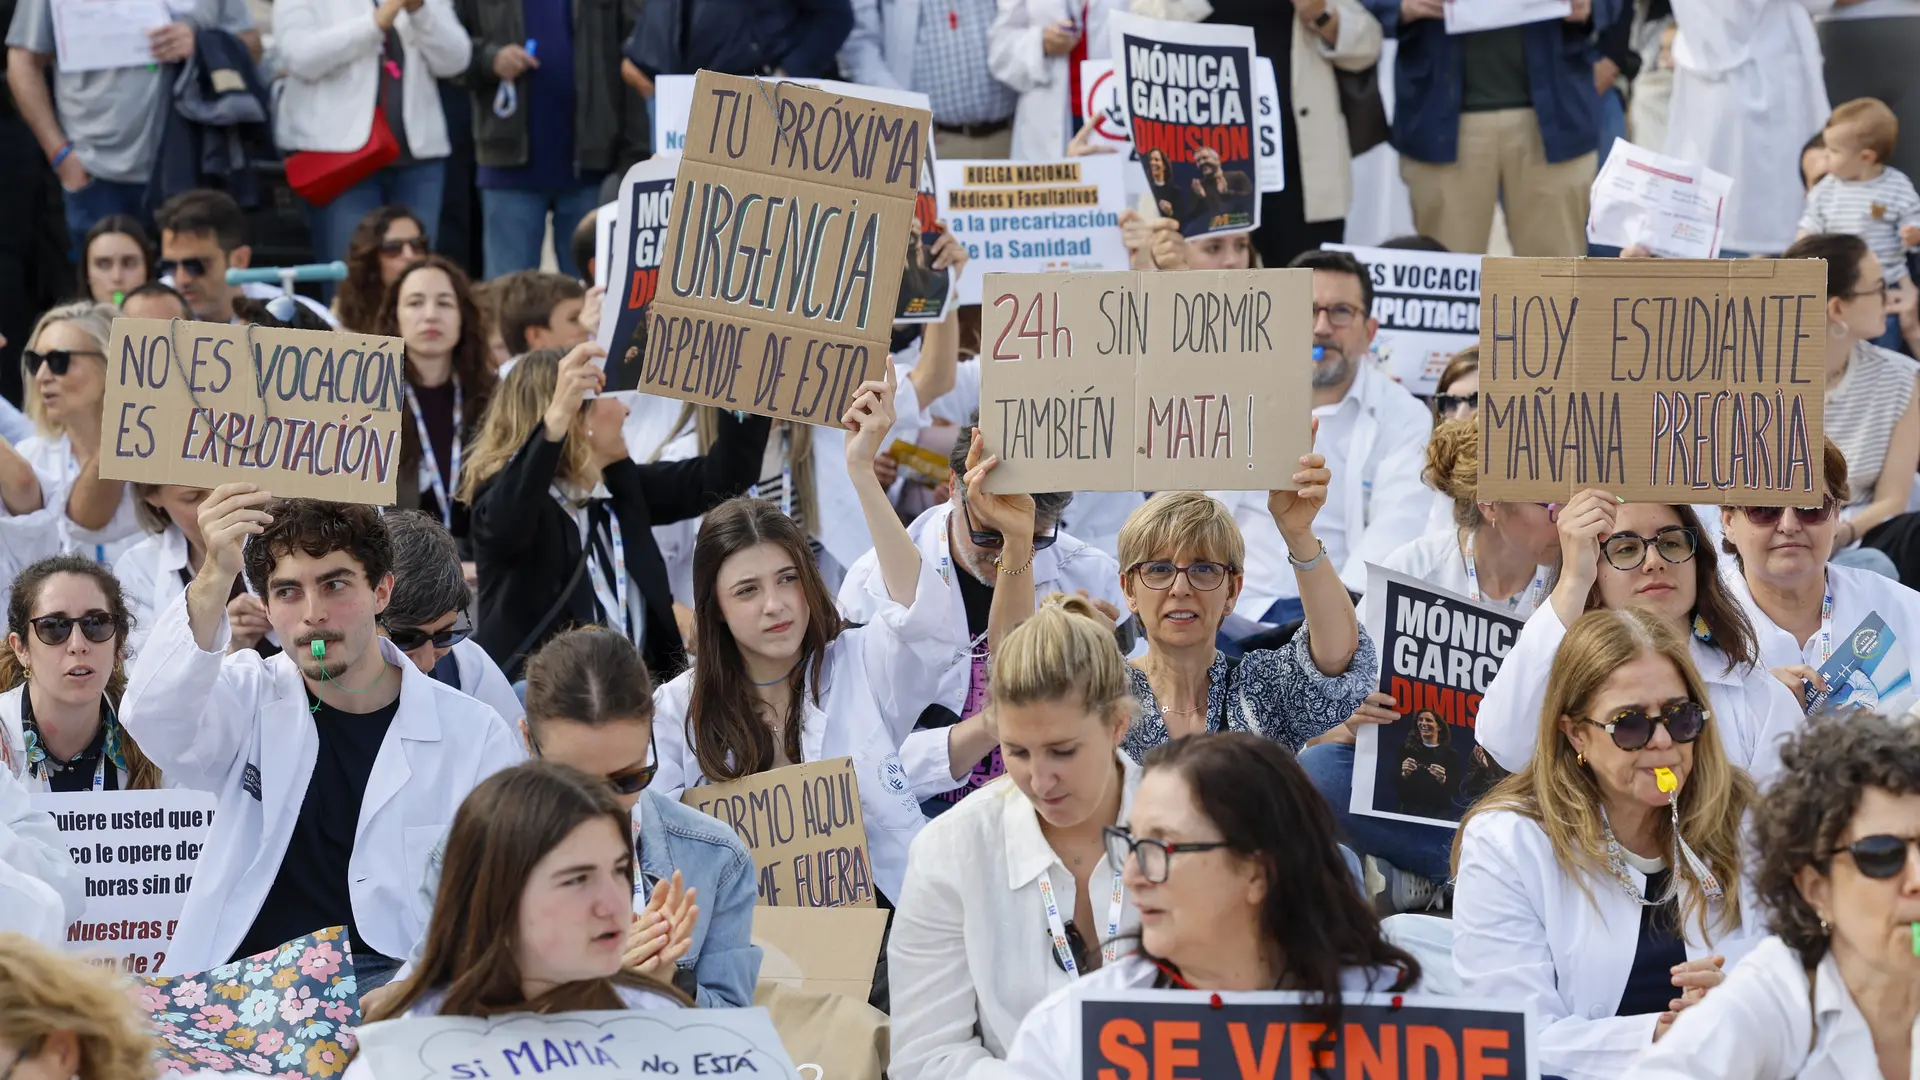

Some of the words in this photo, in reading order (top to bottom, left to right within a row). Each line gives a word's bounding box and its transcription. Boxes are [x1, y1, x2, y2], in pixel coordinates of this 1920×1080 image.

[1129, 44, 1240, 89] MÓNICA
[1131, 80, 1245, 125] GARCÍA
[711, 88, 753, 159] TU
[770, 98, 919, 189] PRÓXIMA
[1133, 116, 1249, 163] DIMISIÓN
[967, 165, 1013, 184] HUELGA
[1016, 163, 1079, 183] NACIONAL
[1007, 195, 1013, 208] y
[1017, 188, 1098, 206] Facultativos
[953, 219, 963, 232] a
[968, 215, 985, 232] la
[990, 209, 1118, 233] precarización
[671, 180, 880, 331] URGENCIA
[985, 241, 1003, 259] la
[1009, 237, 1091, 259] Sanidad
[1393, 265, 1481, 292] VOCACI
[993, 291, 1073, 362] 24h
[1097, 286, 1149, 355] SIN
[1173, 287, 1272, 354] DORMIR
[1370, 296, 1481, 330] PLOTACI
[1492, 293, 1579, 380] HOY
[1611, 294, 1817, 384] ESTUDIANTE
[120, 334, 170, 389] NO
[189, 337, 233, 393] ES
[254, 341, 405, 412] VOCACIÓN
[645, 314, 750, 403] DEPENDE
[753, 332, 791, 412] DE
[791, 339, 869, 423] ESTO
[116, 402, 156, 458] ES
[181, 407, 397, 484] EXPLOTACIÓN
[995, 386, 1114, 460] TAMBIÉN
[1484, 386, 1625, 484] MAÑANA
[1650, 388, 1814, 493] PRECARIA
[111, 808, 164, 830] usted
[168, 810, 203, 830] que
[802, 758, 855, 839] AQUÍ
[69, 845, 91, 864] co
[96, 843, 113, 864] le
[118, 843, 172, 864] opere
[85, 876, 138, 897] horas
[142, 874, 170, 895] sin
[793, 845, 873, 908] FUERA
[66, 919, 162, 942] Nuestras
[121, 953, 148, 974] de
[502, 1034, 620, 1075] MAMÁ
[694, 1049, 758, 1075] ESTÁ
[1097, 1018, 1200, 1080] SE
[1226, 1022, 1510, 1080] VENDE
